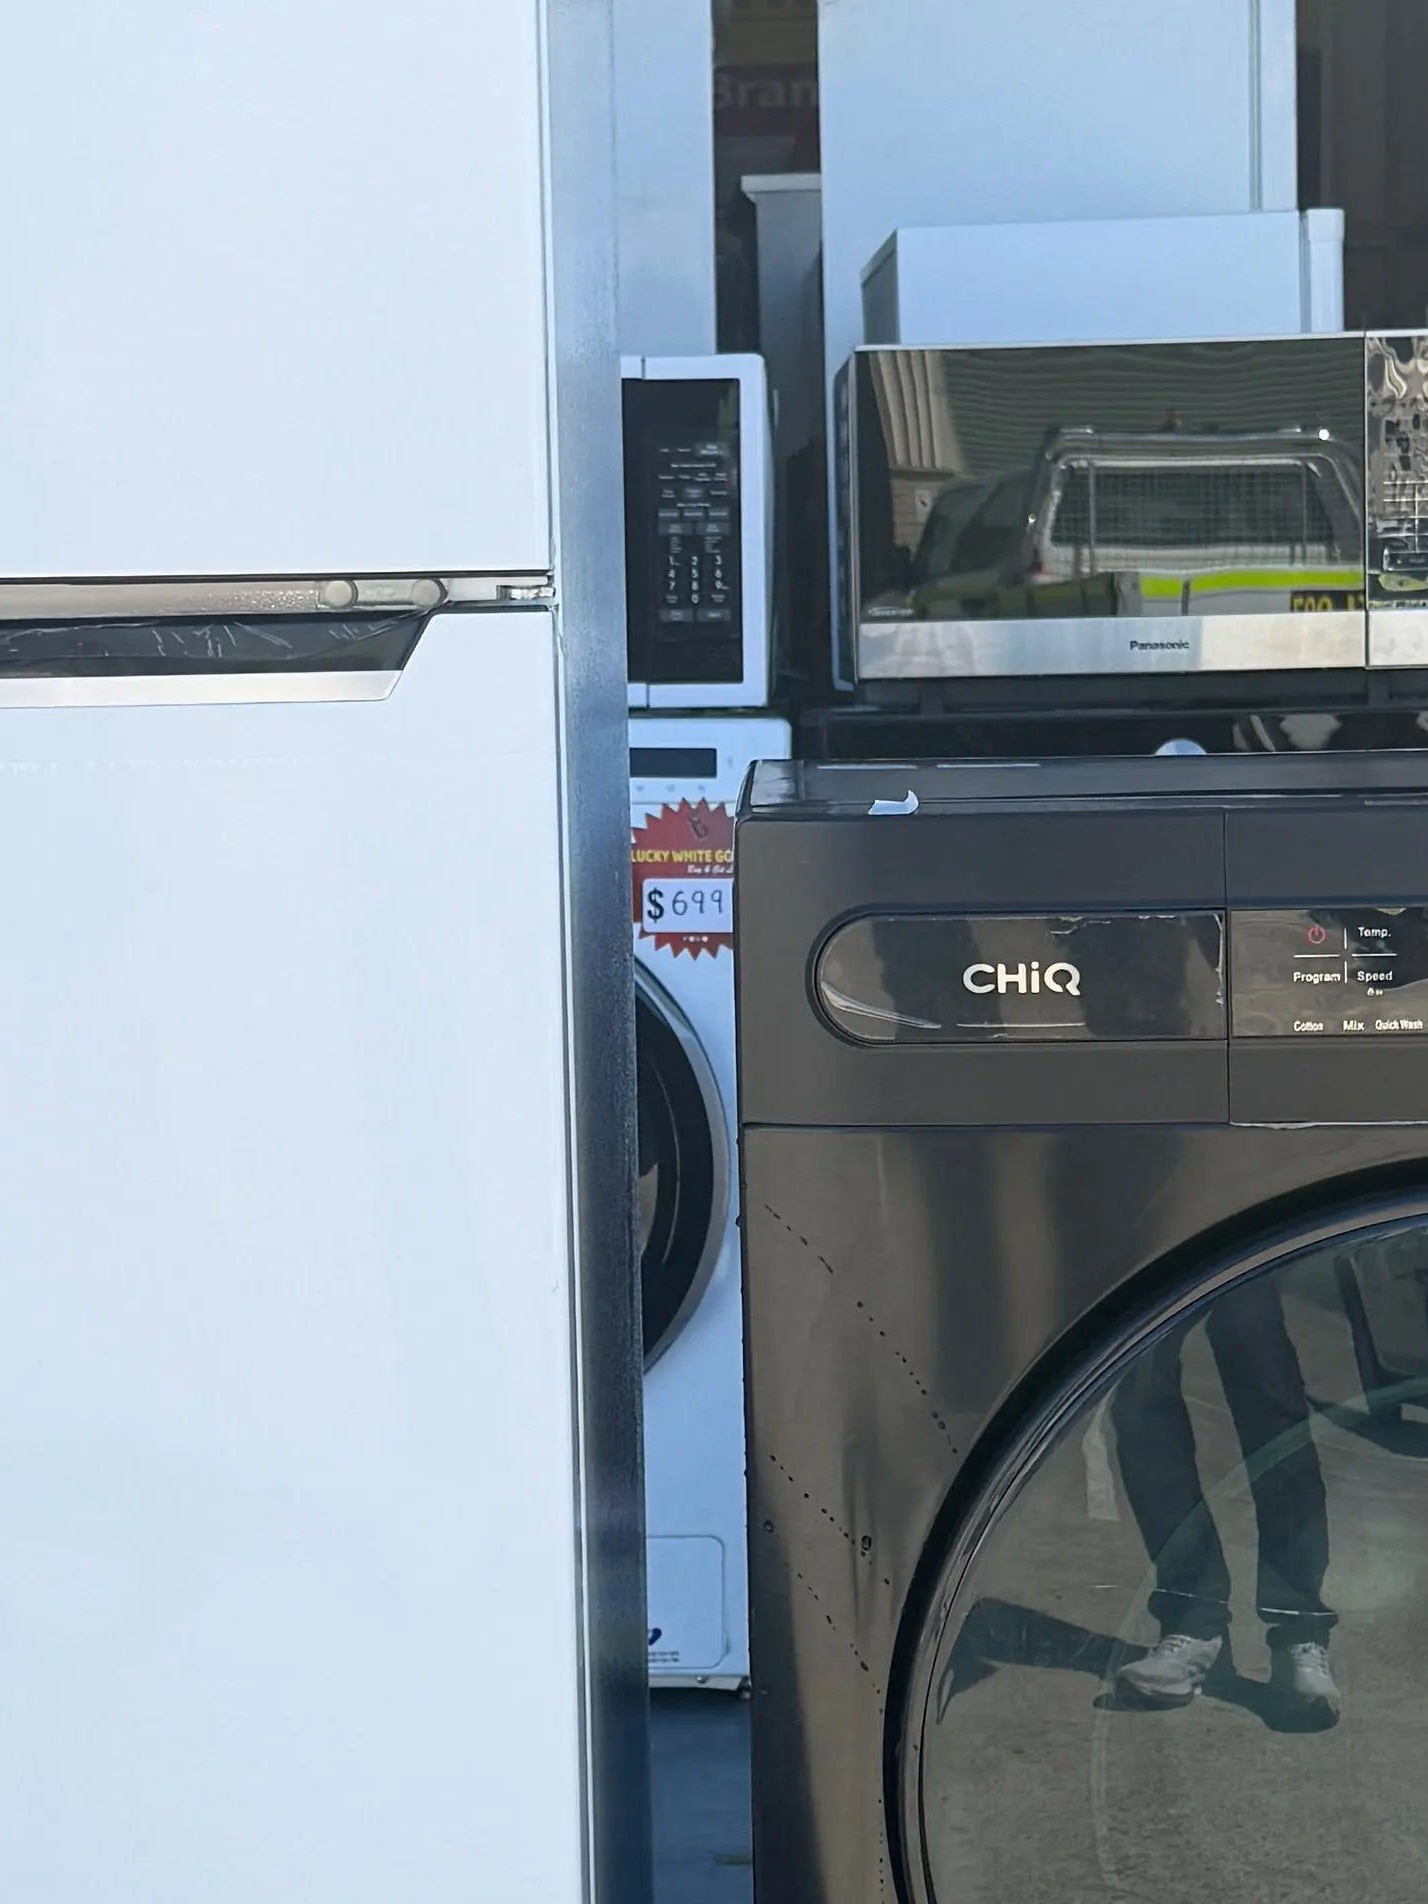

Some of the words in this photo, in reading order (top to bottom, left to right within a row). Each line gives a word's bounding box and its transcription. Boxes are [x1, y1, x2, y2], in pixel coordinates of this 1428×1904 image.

[1129, 639, 1190, 651] Panasonic
[1358, 927, 1391, 938] Temp.
[962, 962, 1081, 996] CHiQ
[1293, 972, 1341, 985] Program
[1357, 971, 1393, 982] Speed
[1343, 1021, 1364, 1031] Mix
